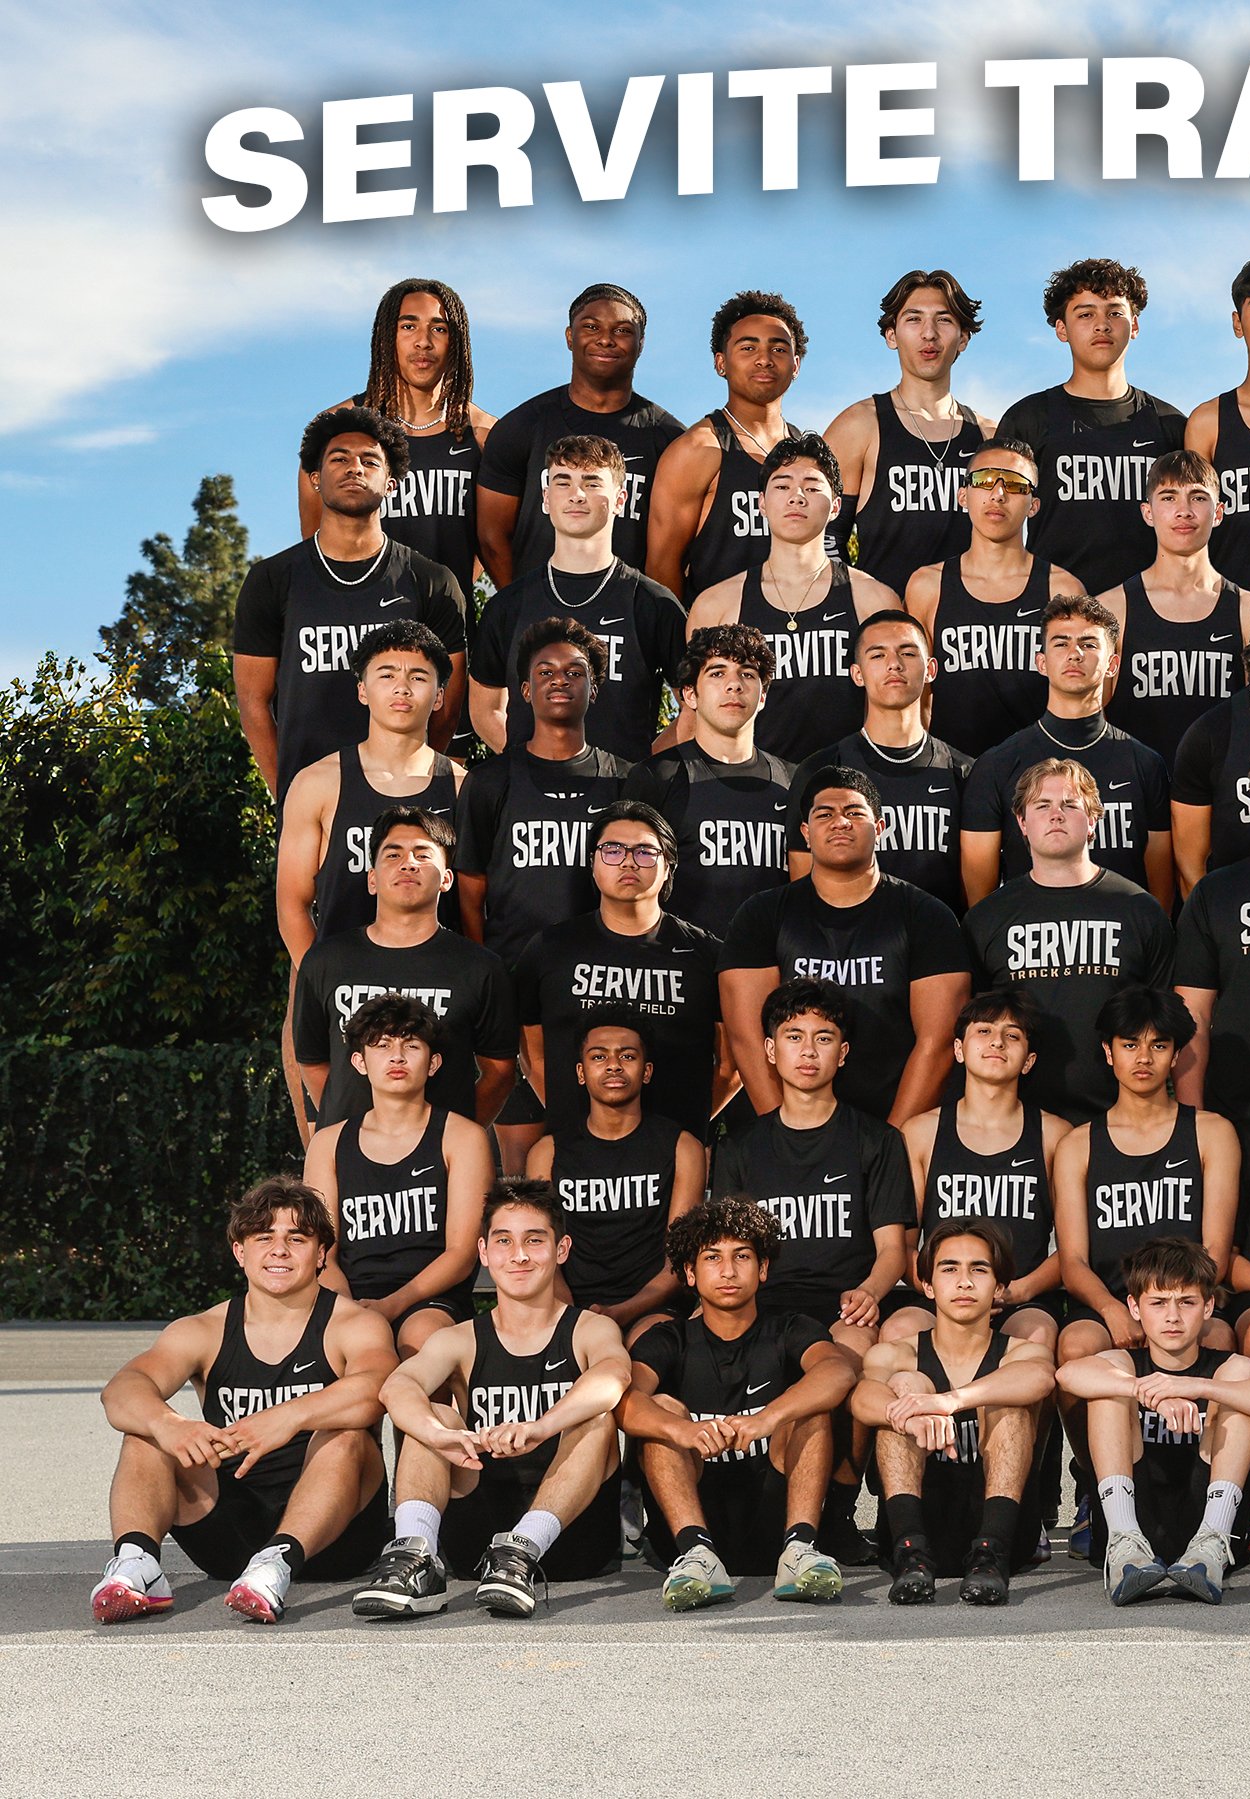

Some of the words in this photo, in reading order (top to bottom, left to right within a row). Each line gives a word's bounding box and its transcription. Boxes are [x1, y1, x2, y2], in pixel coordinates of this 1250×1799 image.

[888, 465, 968, 512] SERVI
[1056, 455, 1156, 501] SERVIT
[765, 630, 850, 680] RVITE
[941, 625, 1042, 673] SERVITE
[1131, 650, 1233, 699] SERVITE
[511, 820, 594, 869] SERVI
[699, 820, 789, 872] SERVIT
[876, 805, 951, 854] RVITE
[1007, 920, 1123, 971] SERVITE
[571, 963, 684, 1003] SERVITE
[1010, 968, 1059, 981] TRACK
[1063, 967, 1072, 978] &
[1078, 966, 1119, 978] FIELD
[639, 1003, 676, 1016] FIELD
[342, 1186, 439, 1242] SERVITE
[559, 1173, 660, 1212] SERVITE
[936, 1173, 1038, 1220] SERVITE
[1095, 1176, 1193, 1230] SERVITE
[512, 1534, 530, 1547] VANS
